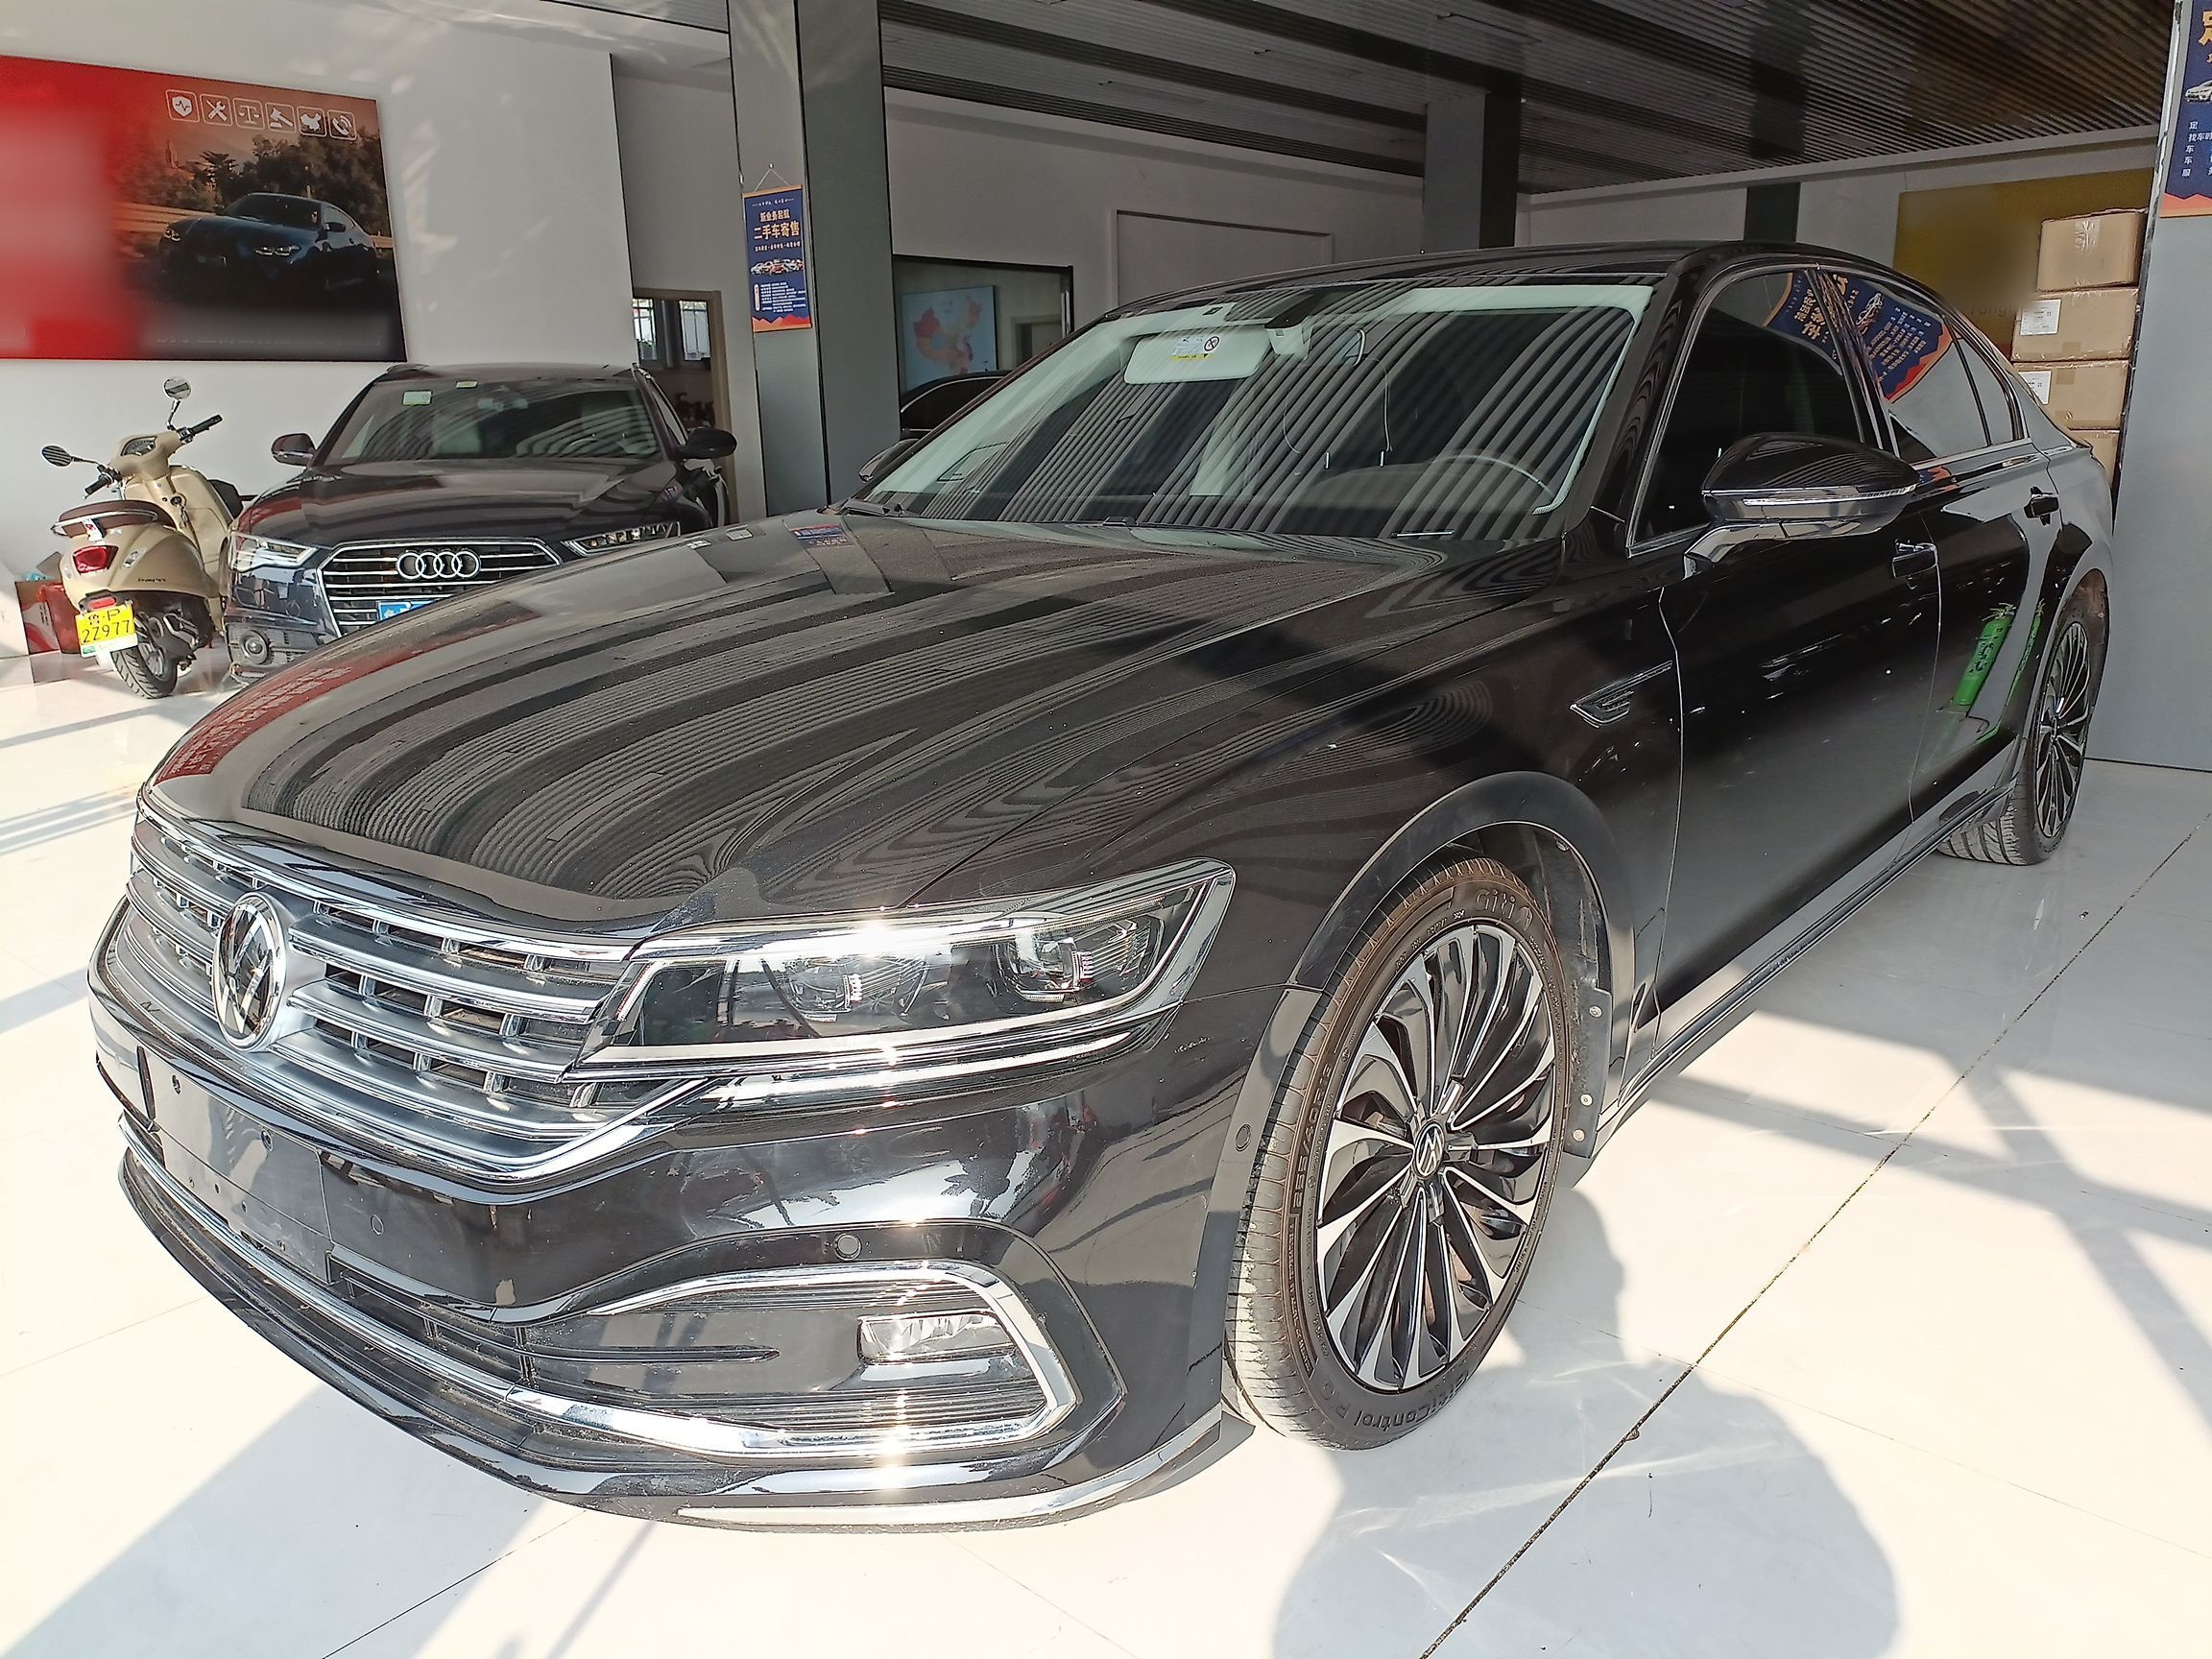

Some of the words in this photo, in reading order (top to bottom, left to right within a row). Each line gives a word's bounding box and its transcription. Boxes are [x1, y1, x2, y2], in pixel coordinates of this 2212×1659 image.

[754, 220, 800, 239] 二手车寄售
